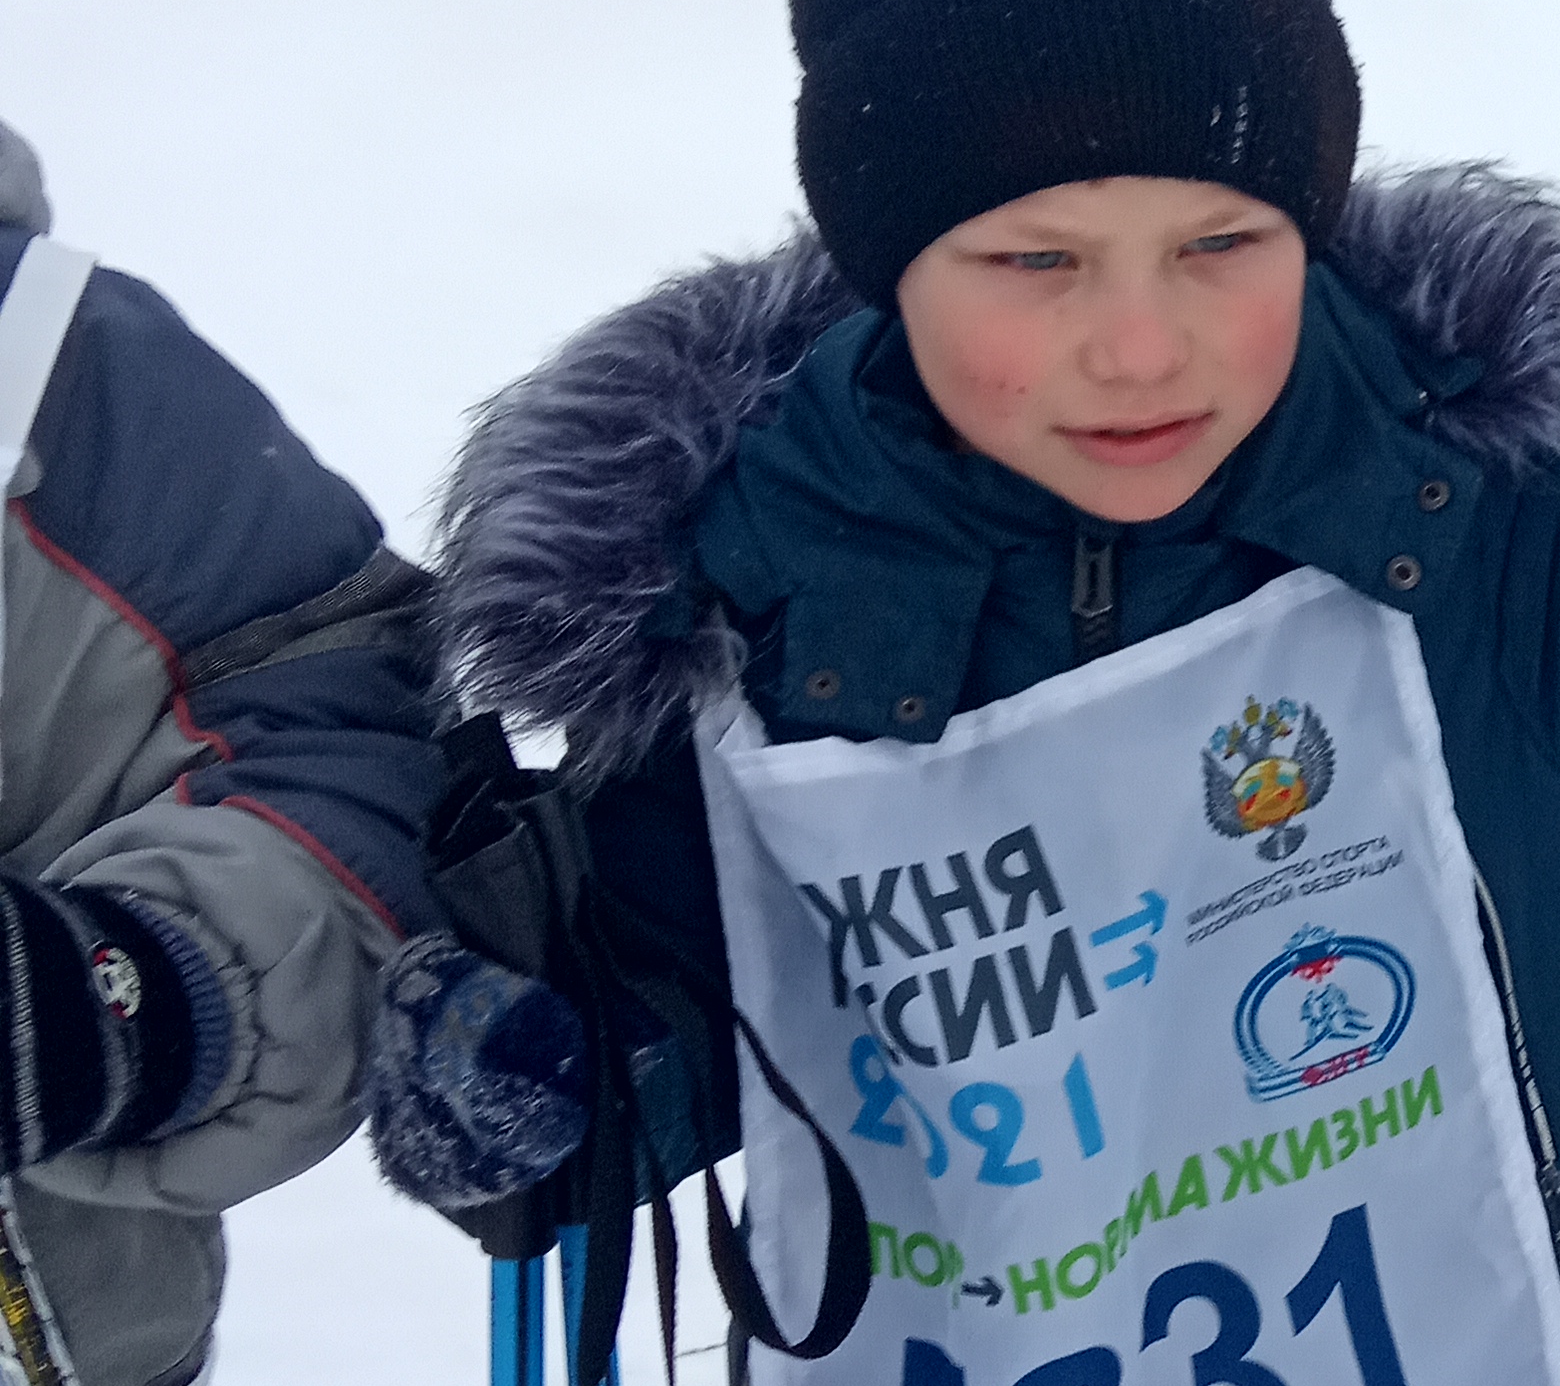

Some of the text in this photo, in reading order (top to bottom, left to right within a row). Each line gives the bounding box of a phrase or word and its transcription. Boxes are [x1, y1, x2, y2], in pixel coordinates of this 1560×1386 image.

[798, 823, 1066, 1009] ЖНЯ
[1185, 849, 1405, 946] РОССИЙСКОЙ ФЕДЕРАЦИИ
[1186, 834, 1391, 926] МИНИСТЕРСТВО СПОРТА
[1006, 1153, 1210, 1314] НОРМА
[1213, 1064, 1444, 1203] ЖИЗНИ
